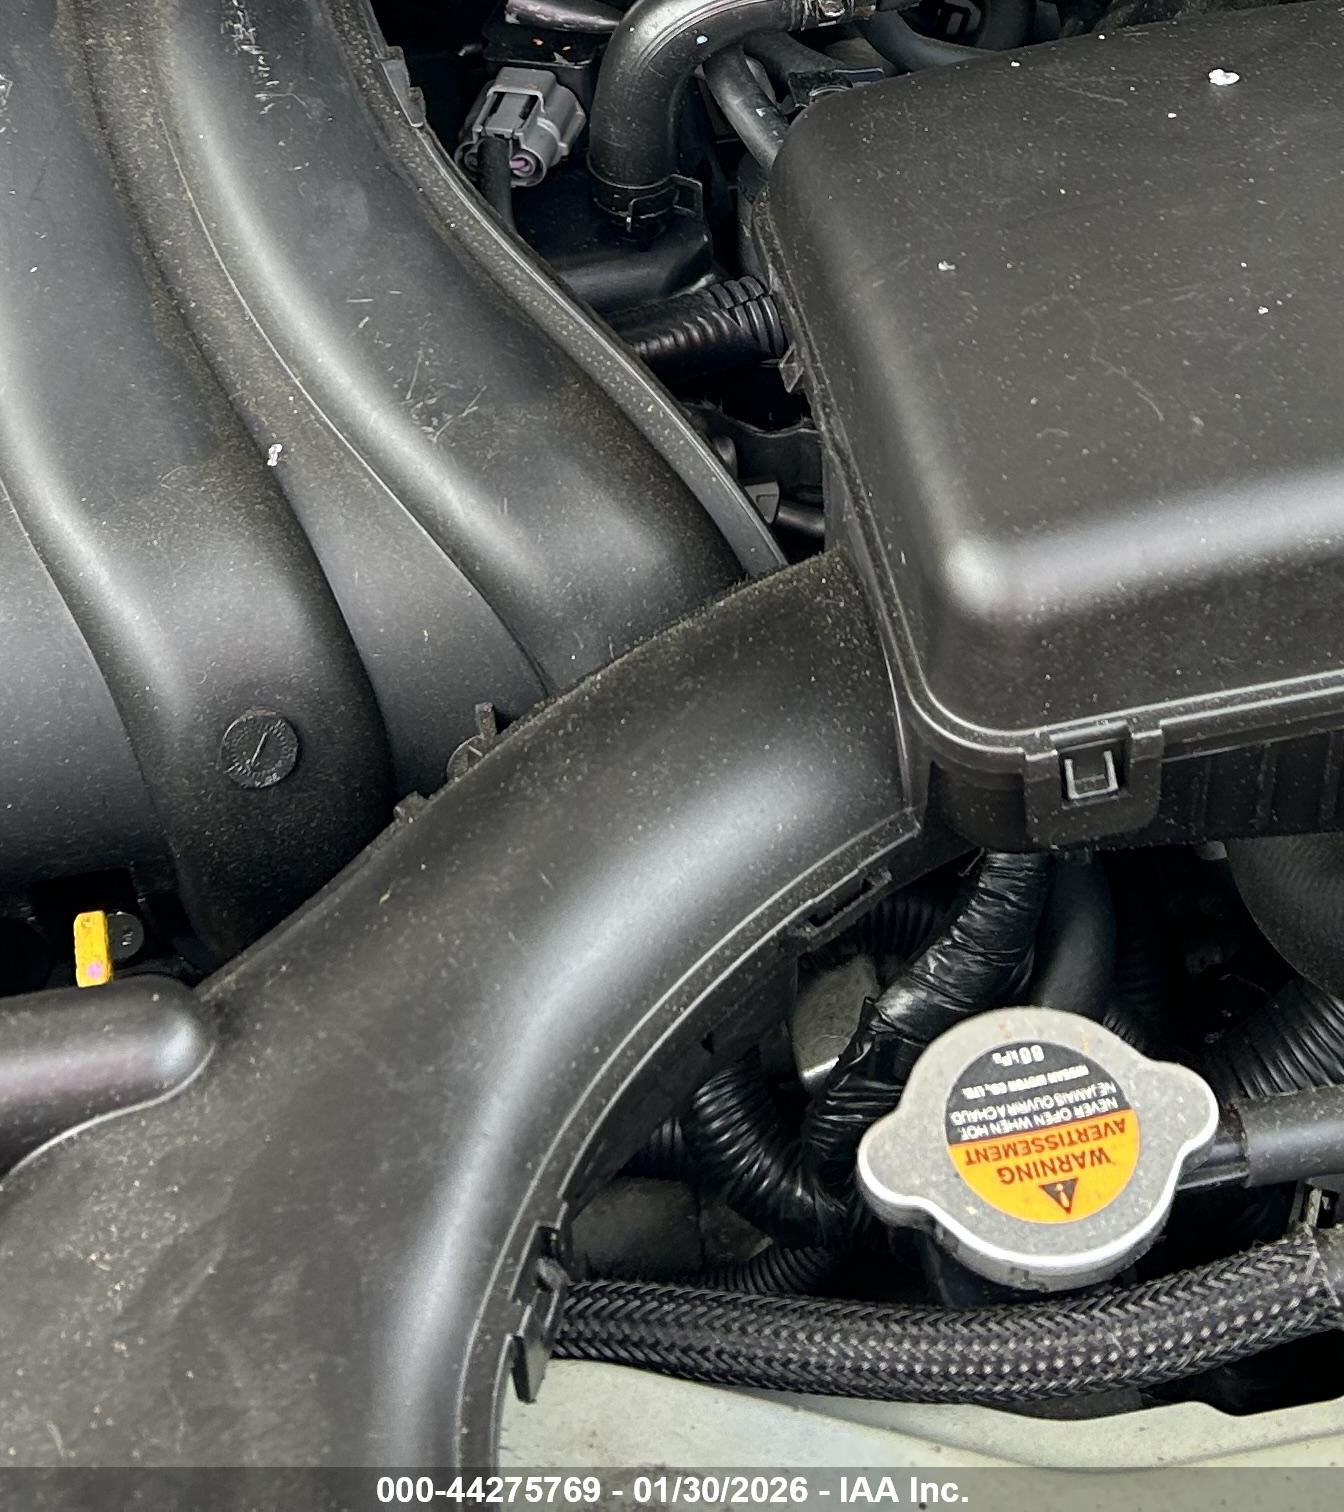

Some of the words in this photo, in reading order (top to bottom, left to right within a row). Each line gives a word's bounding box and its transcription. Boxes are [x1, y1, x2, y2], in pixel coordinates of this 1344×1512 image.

[1054, 1085, 1098, 1103] JAMAIS
[1098, 1081, 1118, 1096] NE
[1007, 1094, 1055, 1116] OUVRIR
[1074, 1096, 1119, 1118] NEVER
[992, 1115, 1033, 1135] WHEN
[1033, 1107, 1073, 1126] OPEN
[965, 1117, 1126, 1166] AVERTISSEMENT
[996, 1147, 1112, 1185] WARNING
